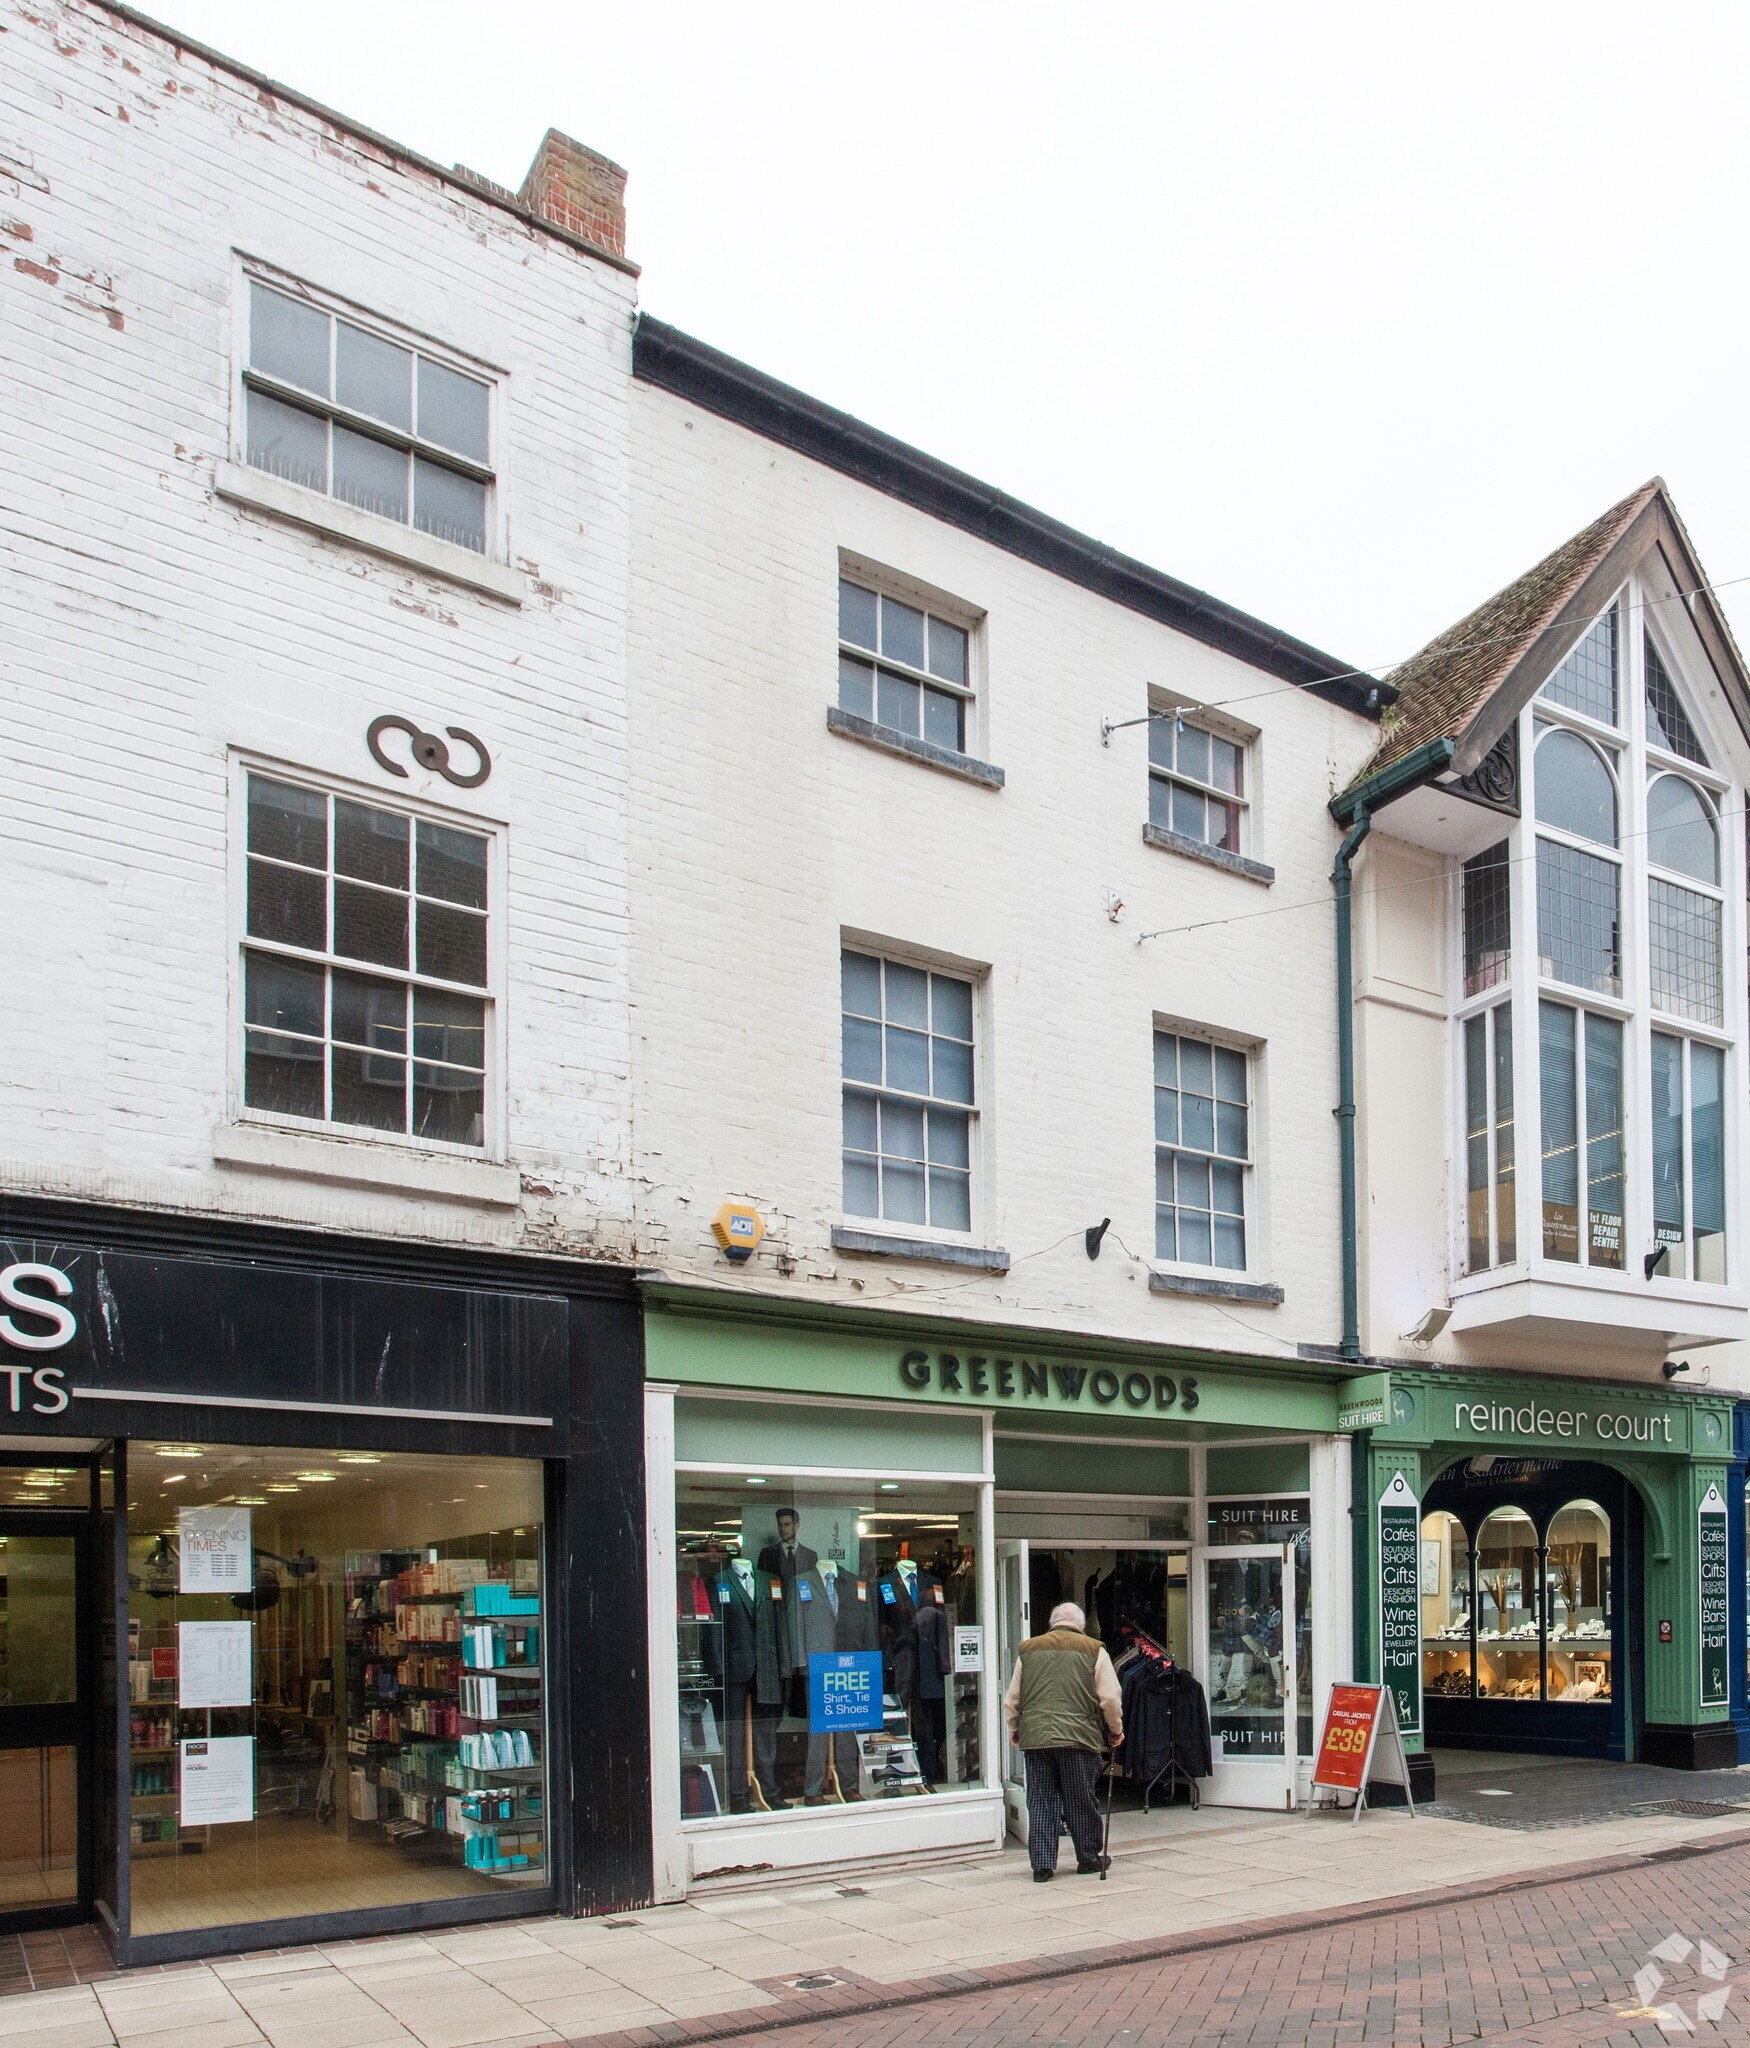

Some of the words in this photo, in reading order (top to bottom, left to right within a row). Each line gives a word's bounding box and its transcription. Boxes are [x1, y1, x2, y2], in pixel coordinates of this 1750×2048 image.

[731, 1220, 753, 1232] ADT
[1590, 1213, 1600, 1223] 1st
[1601, 1214, 1622, 1226] FLOOR
[1593, 1225, 1618, 1237] REPAIR
[1657, 1229, 1682, 1241] DESIGN
[1592, 1237, 1619, 1249] CENTRE
[901, 1350, 1199, 1410] GREENWOODS
[1339, 1398, 1382, 1410] GREENWOODS
[1339, 1415, 1360, 1428] SUIT
[1361, 1411, 1383, 1424] HIRE
[1455, 1400, 1588, 1436] reindeer
[1596, 1413, 1672, 1442] court
[1222, 1510, 1256, 1522] SUIT
[1262, 1510, 1299, 1522] HIRE
[184, 1529, 246, 1541] OPENING
[1383, 1528, 1415, 1541] Cafés
[1702, 1530, 1725, 1542] Cafés
[185, 1541, 227, 1552] TIMES
[1384, 1553, 1415, 1563] SHOPS
[1702, 1551, 1725, 1560] SHOPS
[1384, 1567, 1416, 1584] Gifts
[1702, 1563, 1725, 1578] Gifts
[1384, 1595, 1416, 1603] FASHION
[1702, 1598, 1725, 1609] Wine
[1384, 1607, 1416, 1621] Wine
[1703, 1610, 1725, 1623] Bars
[1385, 1622, 1416, 1637] Bars
[1702, 1633, 1725, 1648] Hair
[1384, 1650, 1416, 1667] Hair
[823, 1671, 870, 1691] FREE
[824, 1692, 852, 1704] Shirt,
[854, 1691, 870, 1702] Tie
[825, 1704, 834, 1715] &
[836, 1704, 868, 1714] Shoes
[1332, 1710, 1350, 1718] CASUAL
[1351, 1712, 1371, 1720] JACKETS
[1221, 1730, 1254, 1742] SUIT
[1261, 1731, 1285, 1743] HIR
[1325, 1727, 1367, 1753] £39
